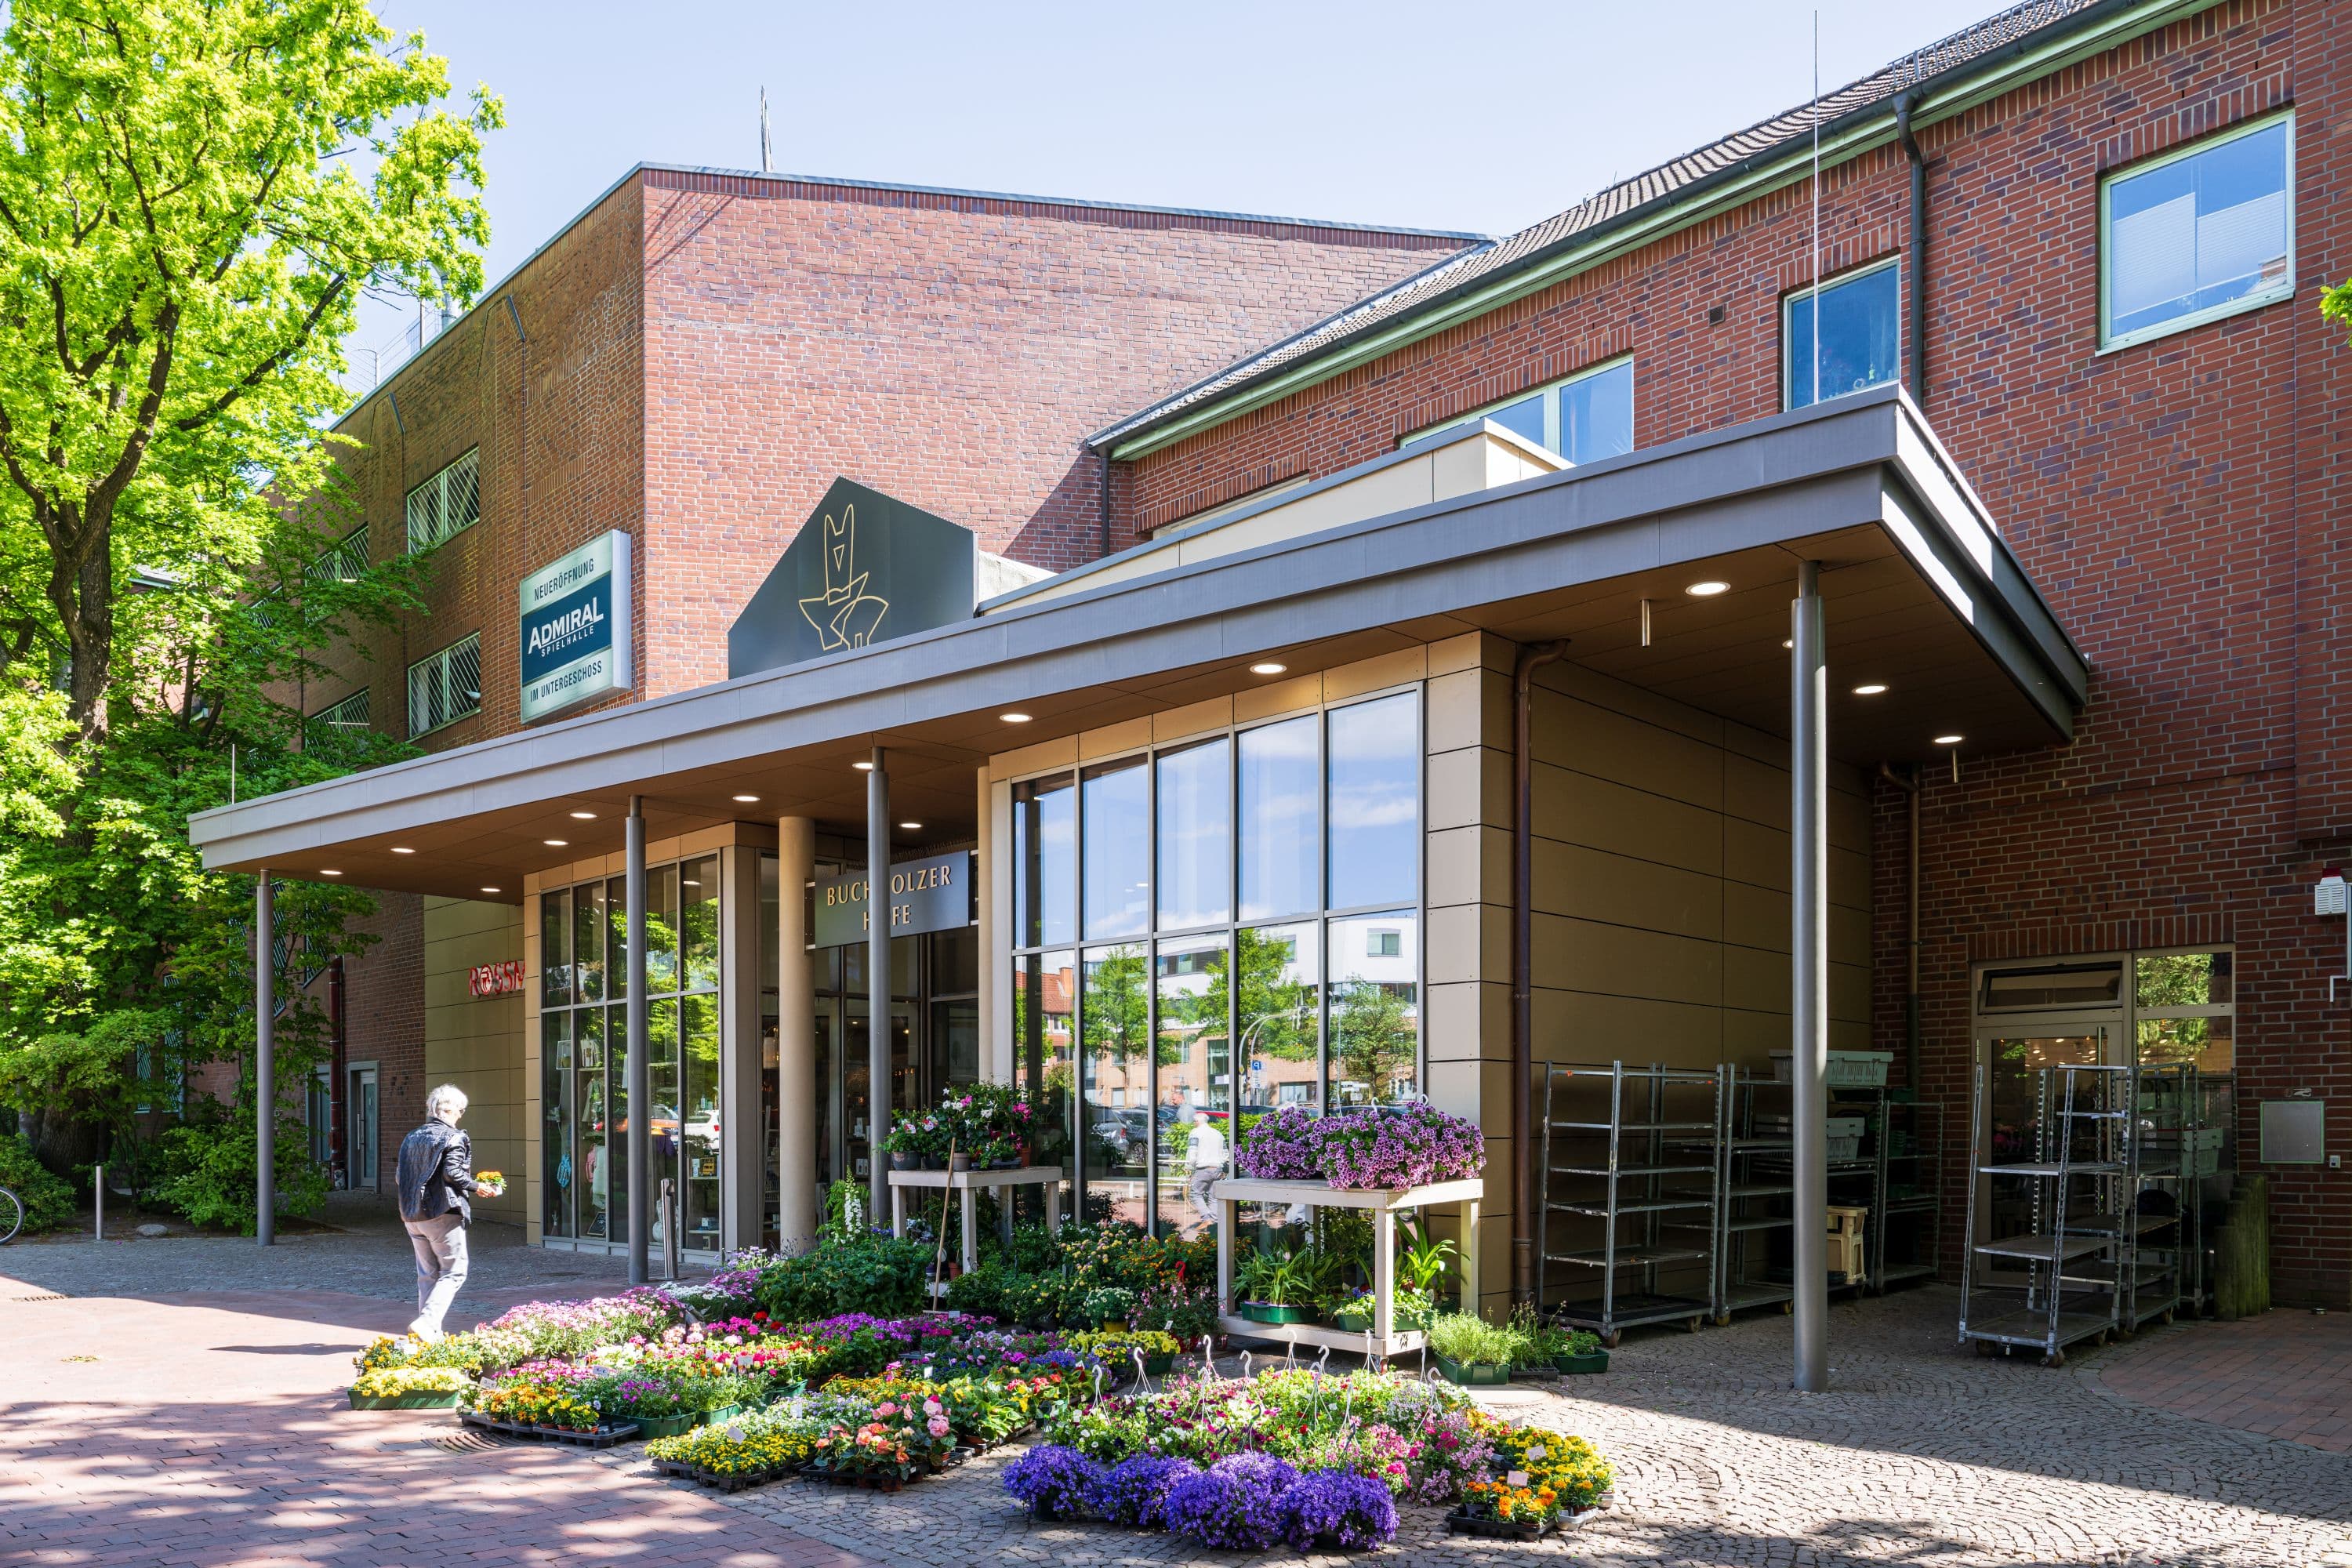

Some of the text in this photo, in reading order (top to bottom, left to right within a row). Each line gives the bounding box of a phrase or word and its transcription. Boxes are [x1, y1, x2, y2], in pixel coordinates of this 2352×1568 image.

[534, 557, 594, 601] NEUERÖFFNUNG
[528, 597, 604, 655] ADMIRAL
[541, 625, 593, 658] SPIELHALLE
[530, 660, 602, 703] IM UNTERGESCHOSS
[827, 865, 952, 906] BUCHOLZER
[863, 904, 911, 931] HFE
